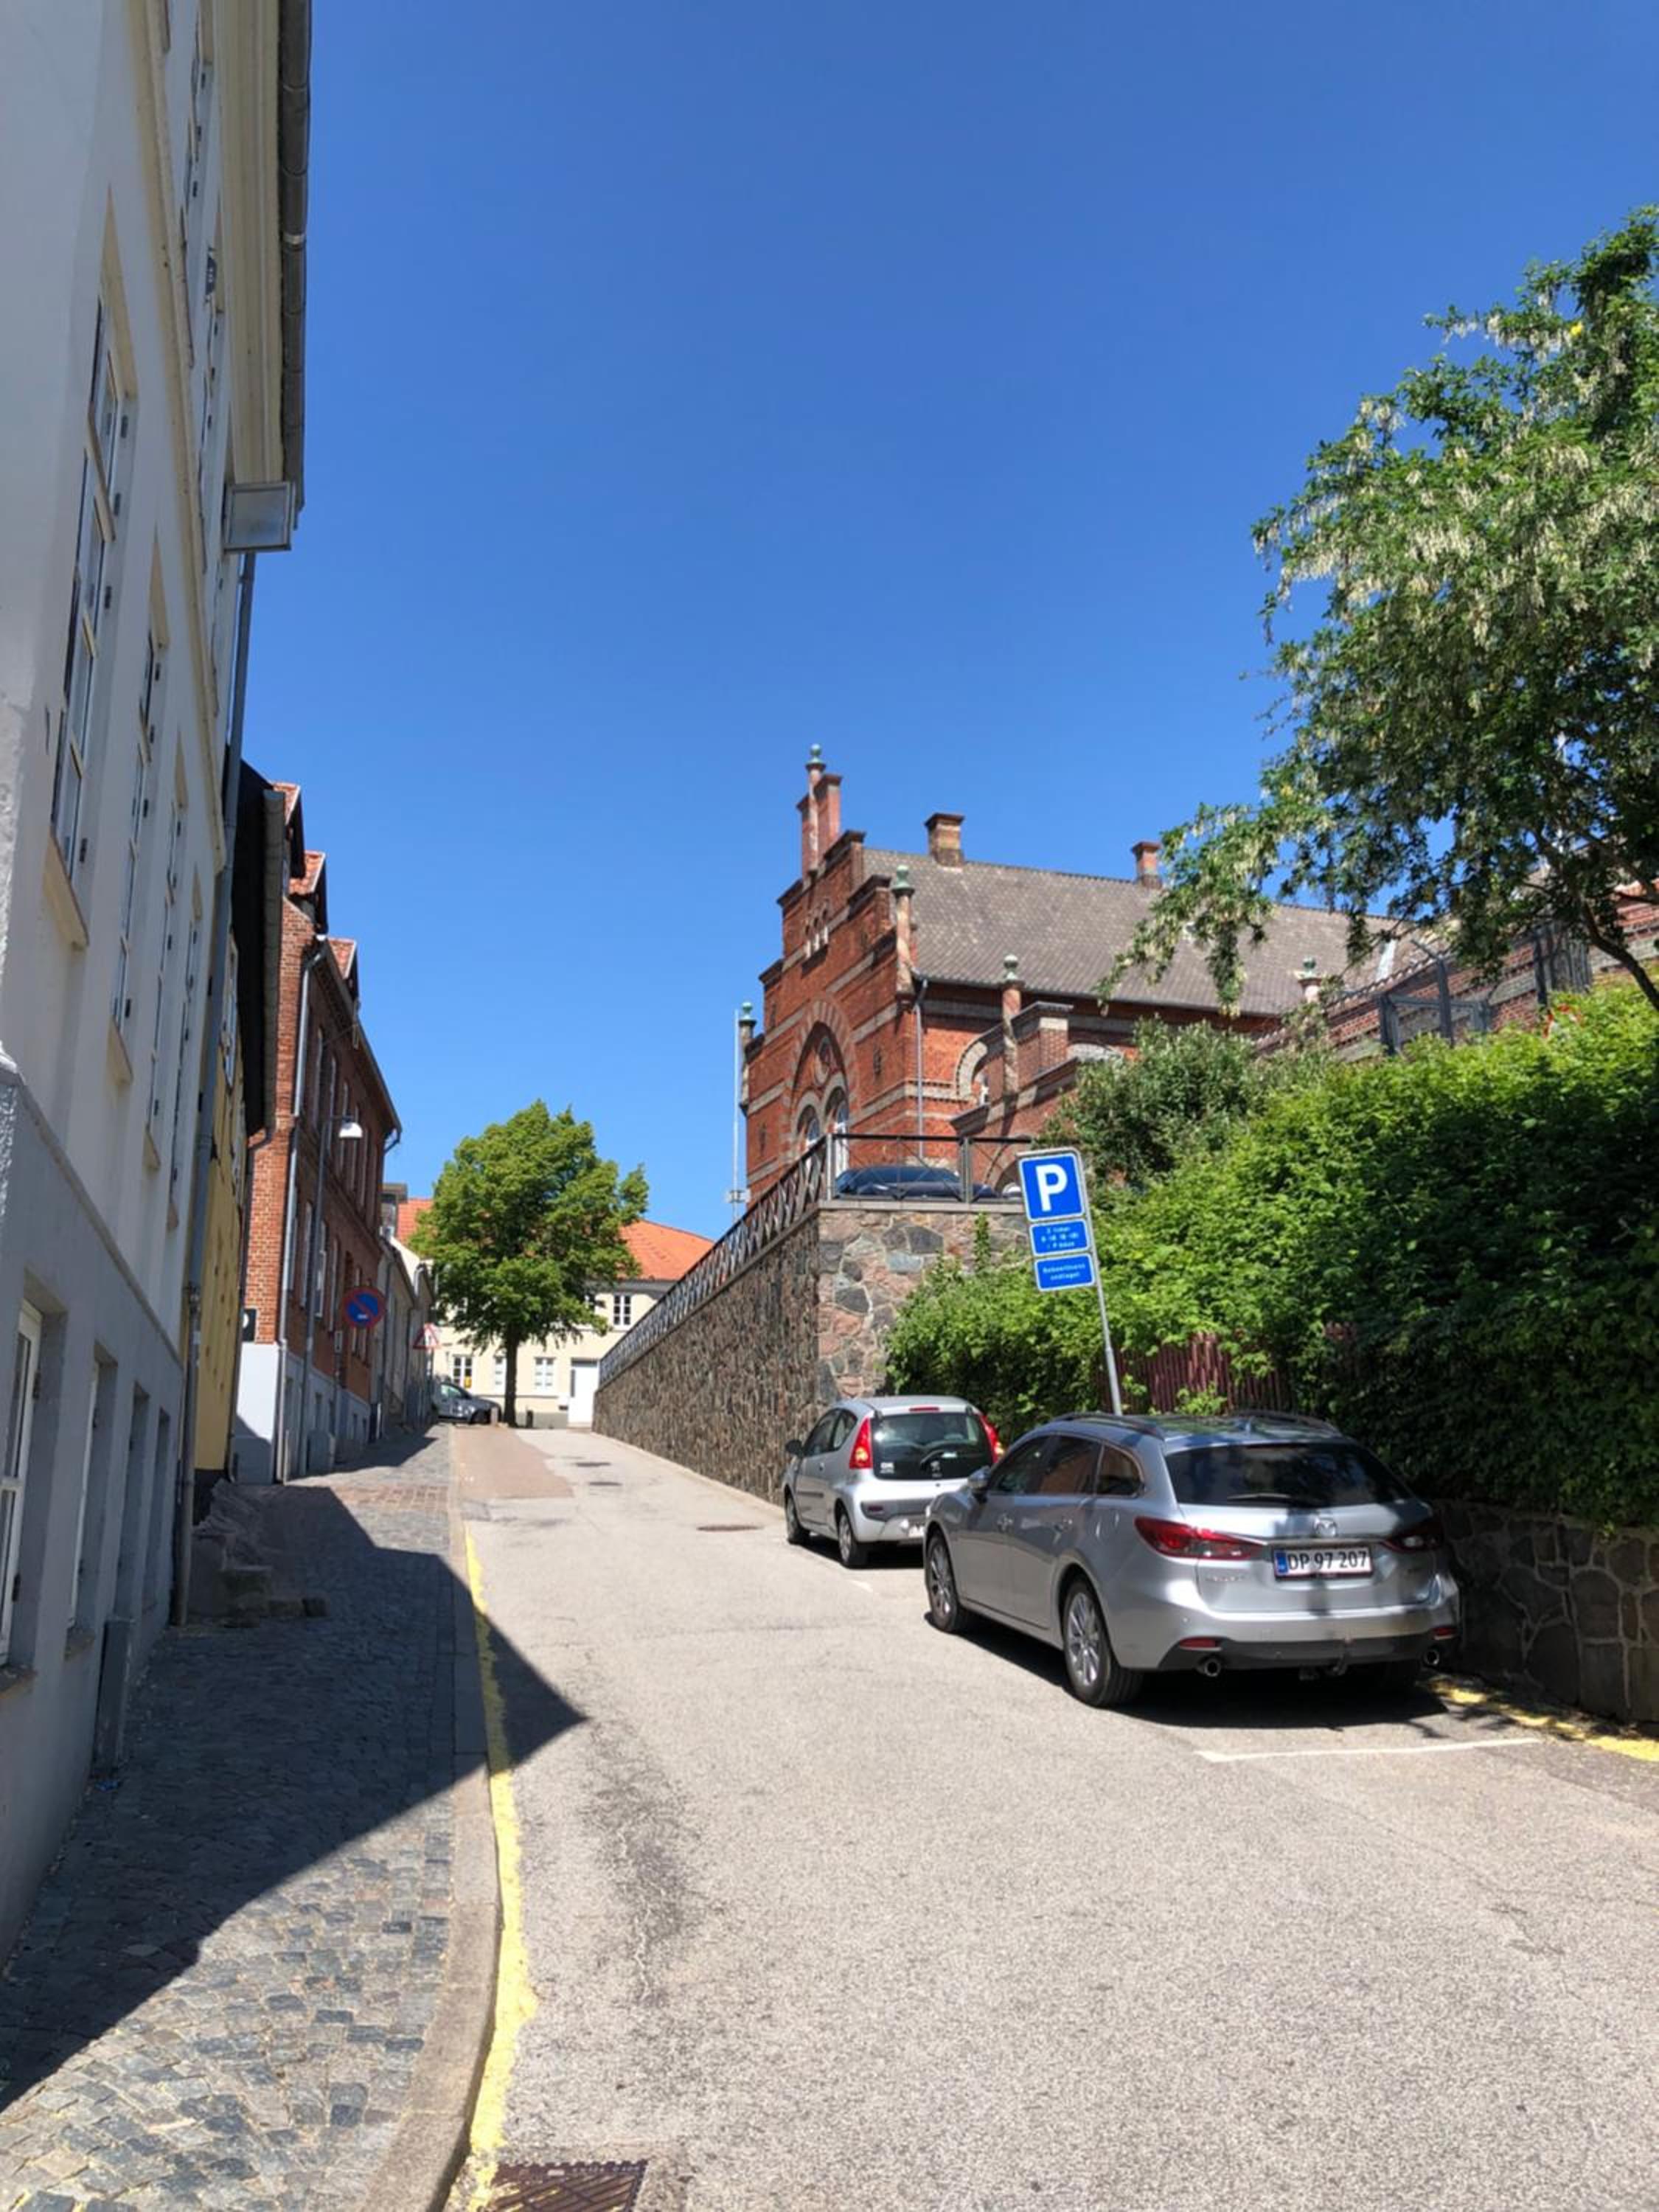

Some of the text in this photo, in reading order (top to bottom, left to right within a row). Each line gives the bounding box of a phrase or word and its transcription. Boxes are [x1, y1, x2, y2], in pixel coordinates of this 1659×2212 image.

[1035, 1164, 1068, 1211] P
[1287, 1551, 1366, 1570] DP 97 207
